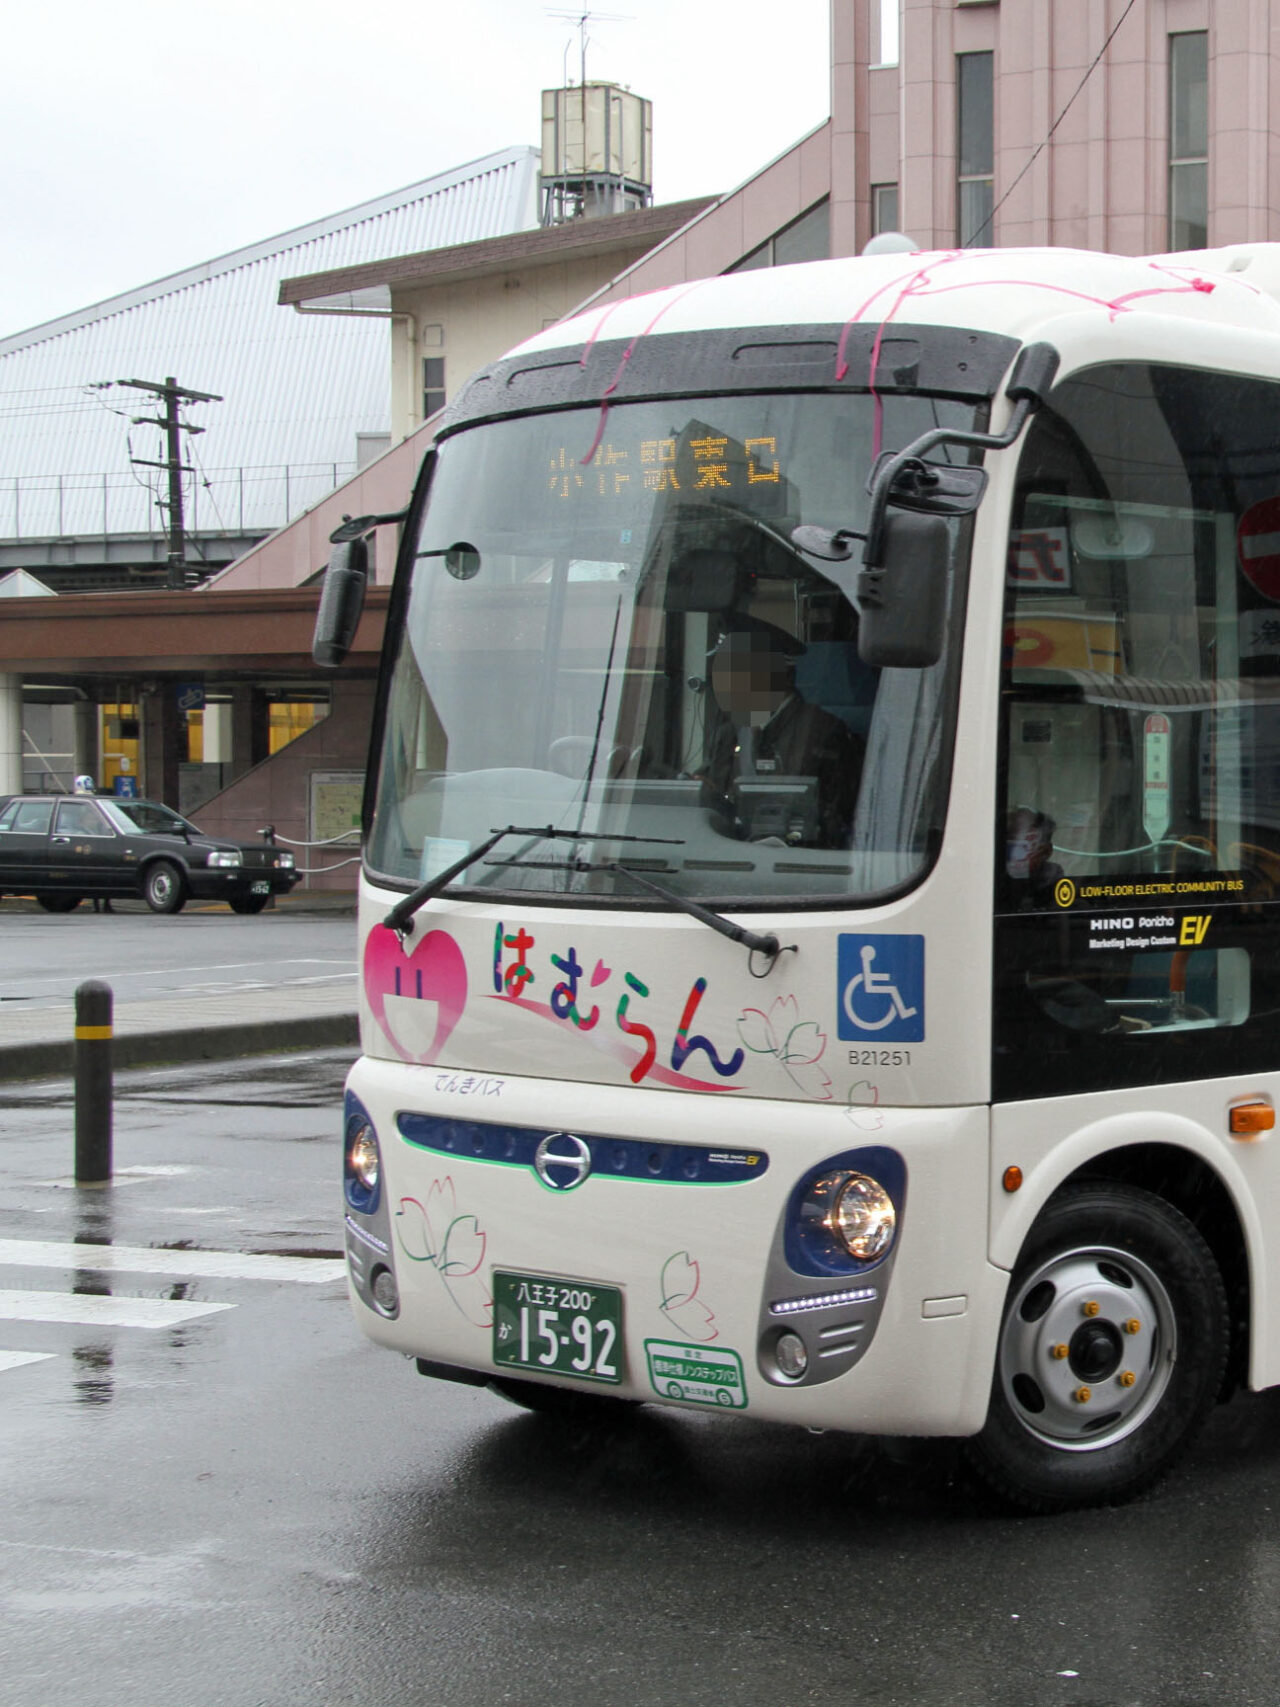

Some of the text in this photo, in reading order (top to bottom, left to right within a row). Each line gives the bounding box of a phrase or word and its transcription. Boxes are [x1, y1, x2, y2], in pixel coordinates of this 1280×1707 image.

[1080, 880, 1244, 897] LOW-FLOOR ELECTRIC COMMUNITY BUS
[1090, 917, 1134, 930] HINO
[1179, 915, 1212, 945] EV
[1089, 935, 1177, 950] Marketing Design Custom
[494, 921, 745, 1083] はむらん
[848, 1050, 911, 1066] B21251
[520, 1307, 617, 1376] 15-92
